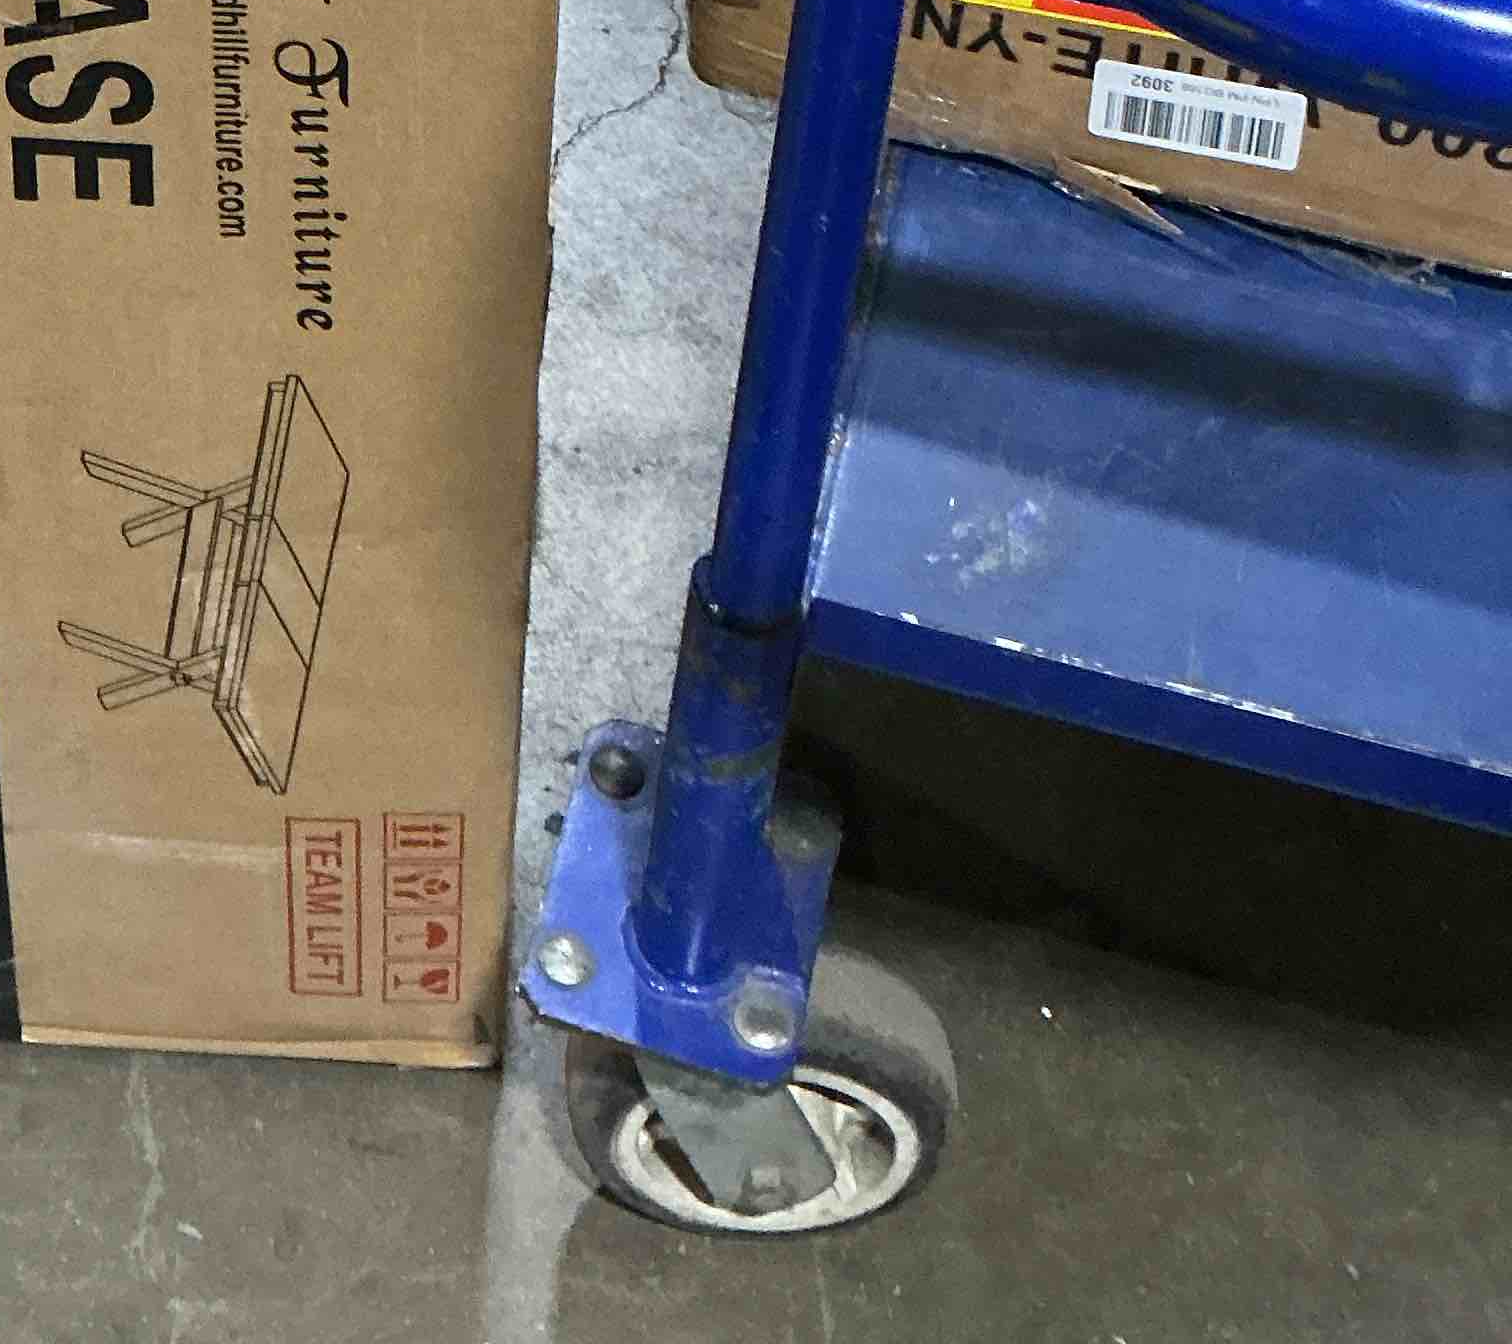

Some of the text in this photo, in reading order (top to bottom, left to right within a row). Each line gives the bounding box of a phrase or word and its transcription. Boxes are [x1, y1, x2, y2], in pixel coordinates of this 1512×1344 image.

[1129, 73, 1175, 94] 3092
[273, 37, 350, 331] Furniture
[304, 829, 345, 986] TEAM LIFT
